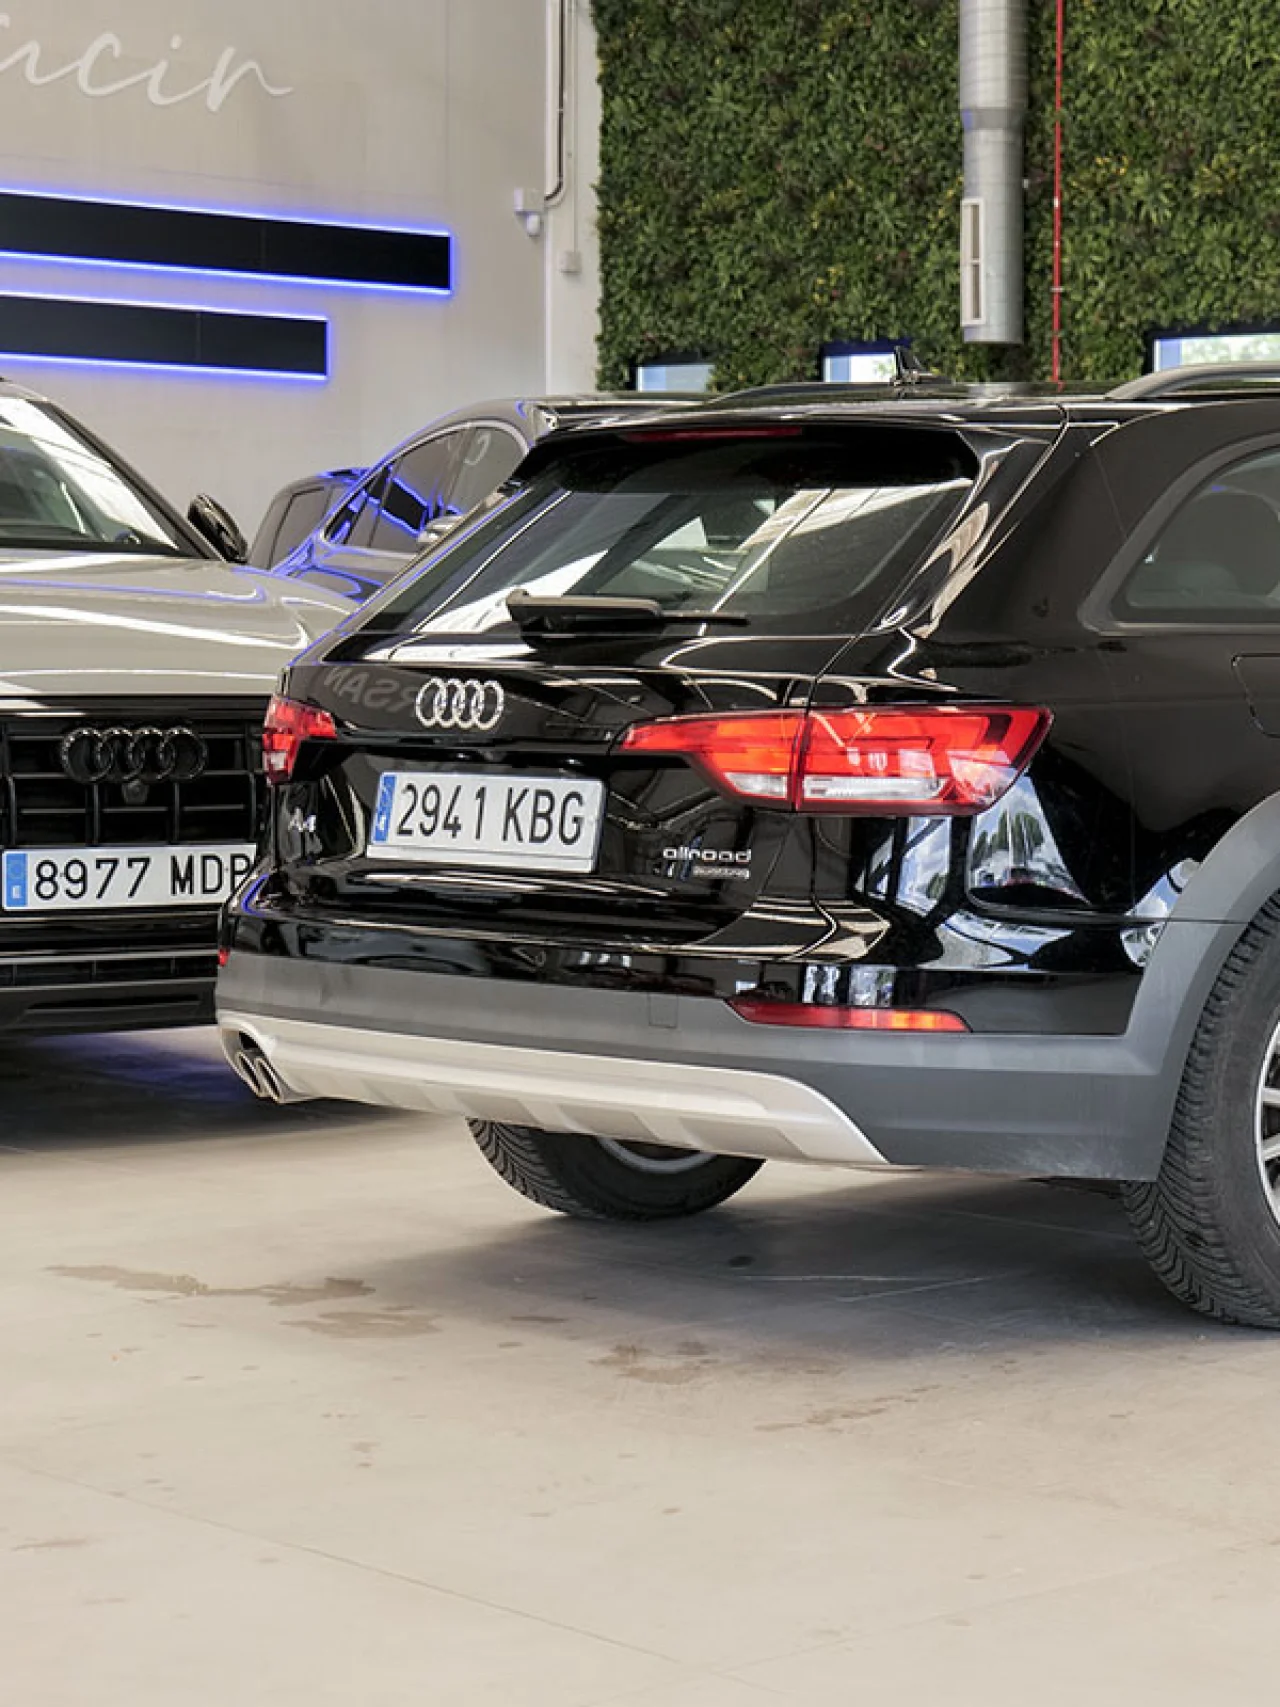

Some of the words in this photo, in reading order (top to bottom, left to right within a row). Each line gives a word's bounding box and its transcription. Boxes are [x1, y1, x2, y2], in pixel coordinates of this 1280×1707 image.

[396, 783, 487, 840] 2941
[502, 786, 585, 845] KBG
[35, 857, 152, 900] 8977
